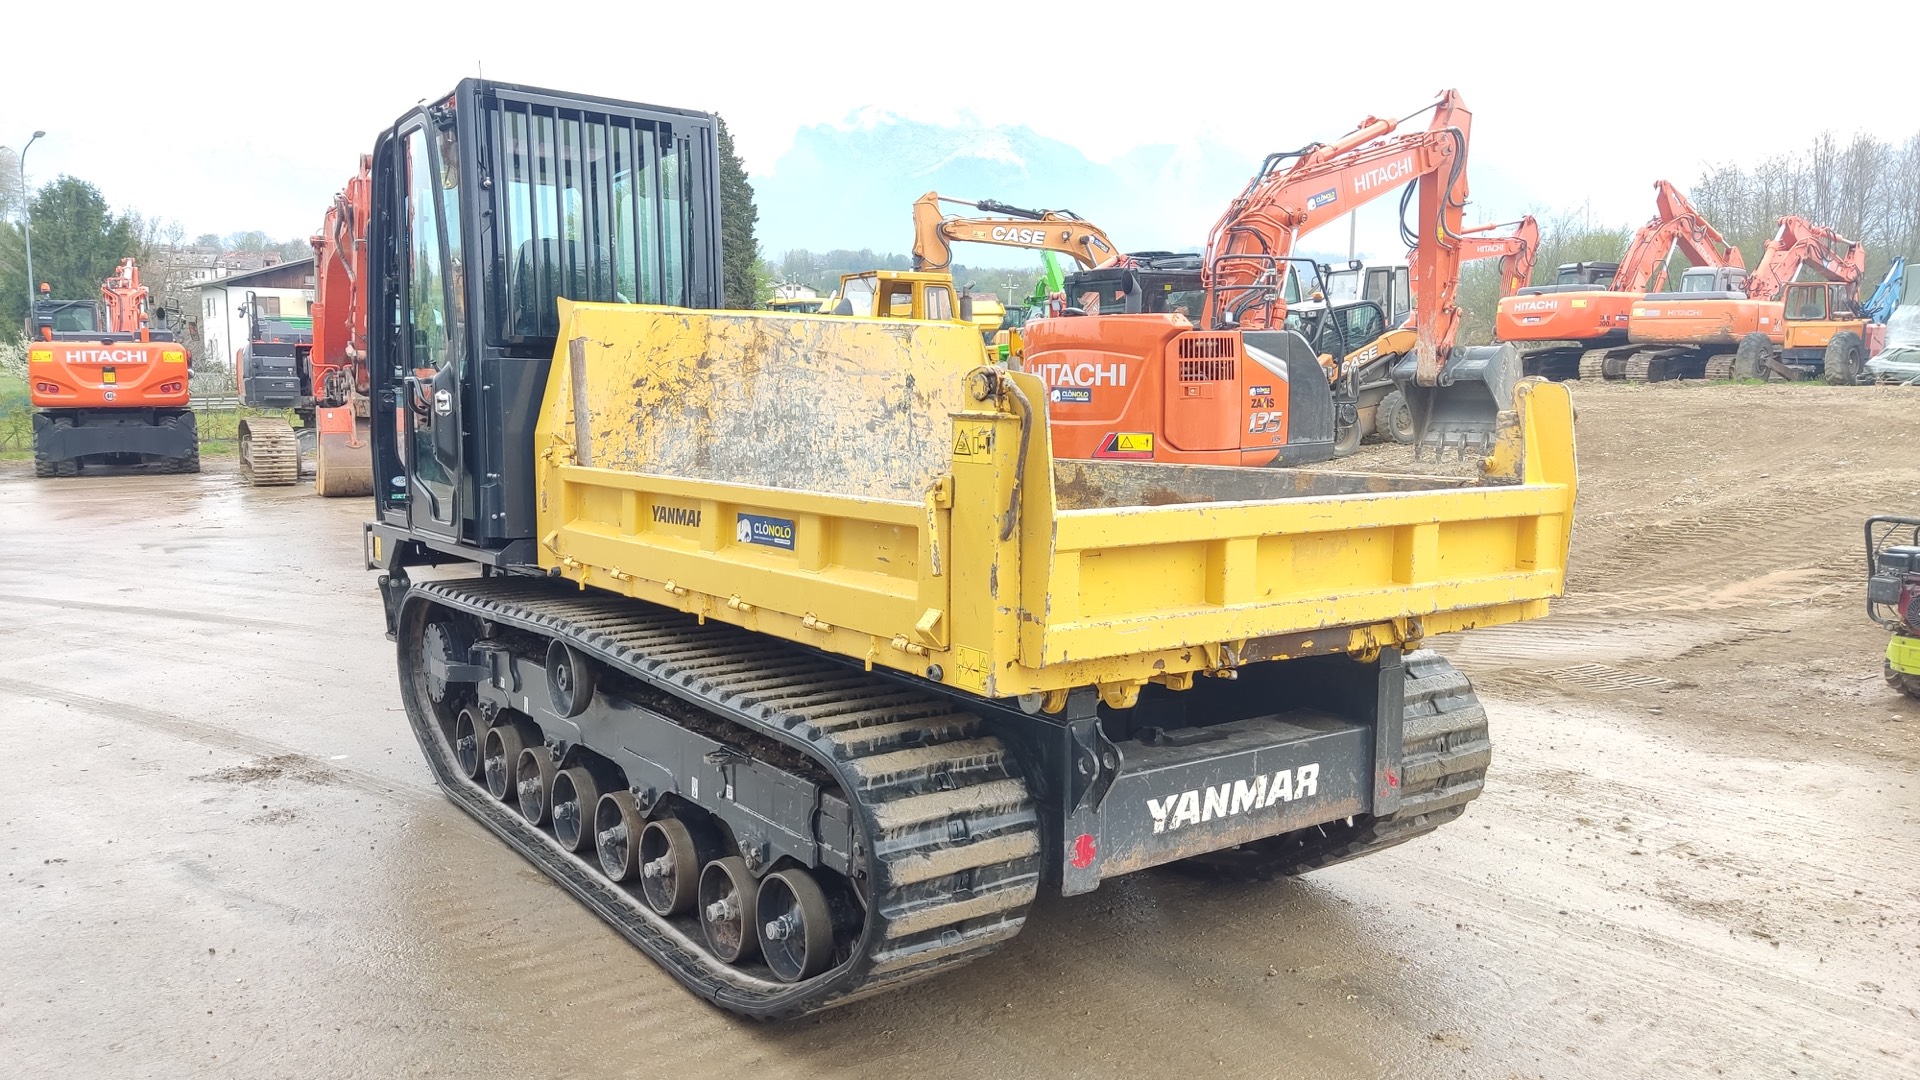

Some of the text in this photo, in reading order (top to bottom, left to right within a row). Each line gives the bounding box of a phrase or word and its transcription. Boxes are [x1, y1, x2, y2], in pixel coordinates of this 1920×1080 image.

[1354, 156, 1413, 194] HITACHI
[991, 225, 1047, 245] CASE
[1476, 244, 1504, 253] HITACHI
[1513, 300, 1558, 311] HITACHI
[1667, 309, 1703, 317] HITACHI
[65, 350, 148, 363] HITACHI
[1341, 345, 1378, 373] CASE
[1031, 363, 1127, 386] HITACHI
[1251, 397, 1275, 408] ZAXIS
[1248, 411, 1283, 434] 135
[1146, 762, 1320, 835] YANMAR
